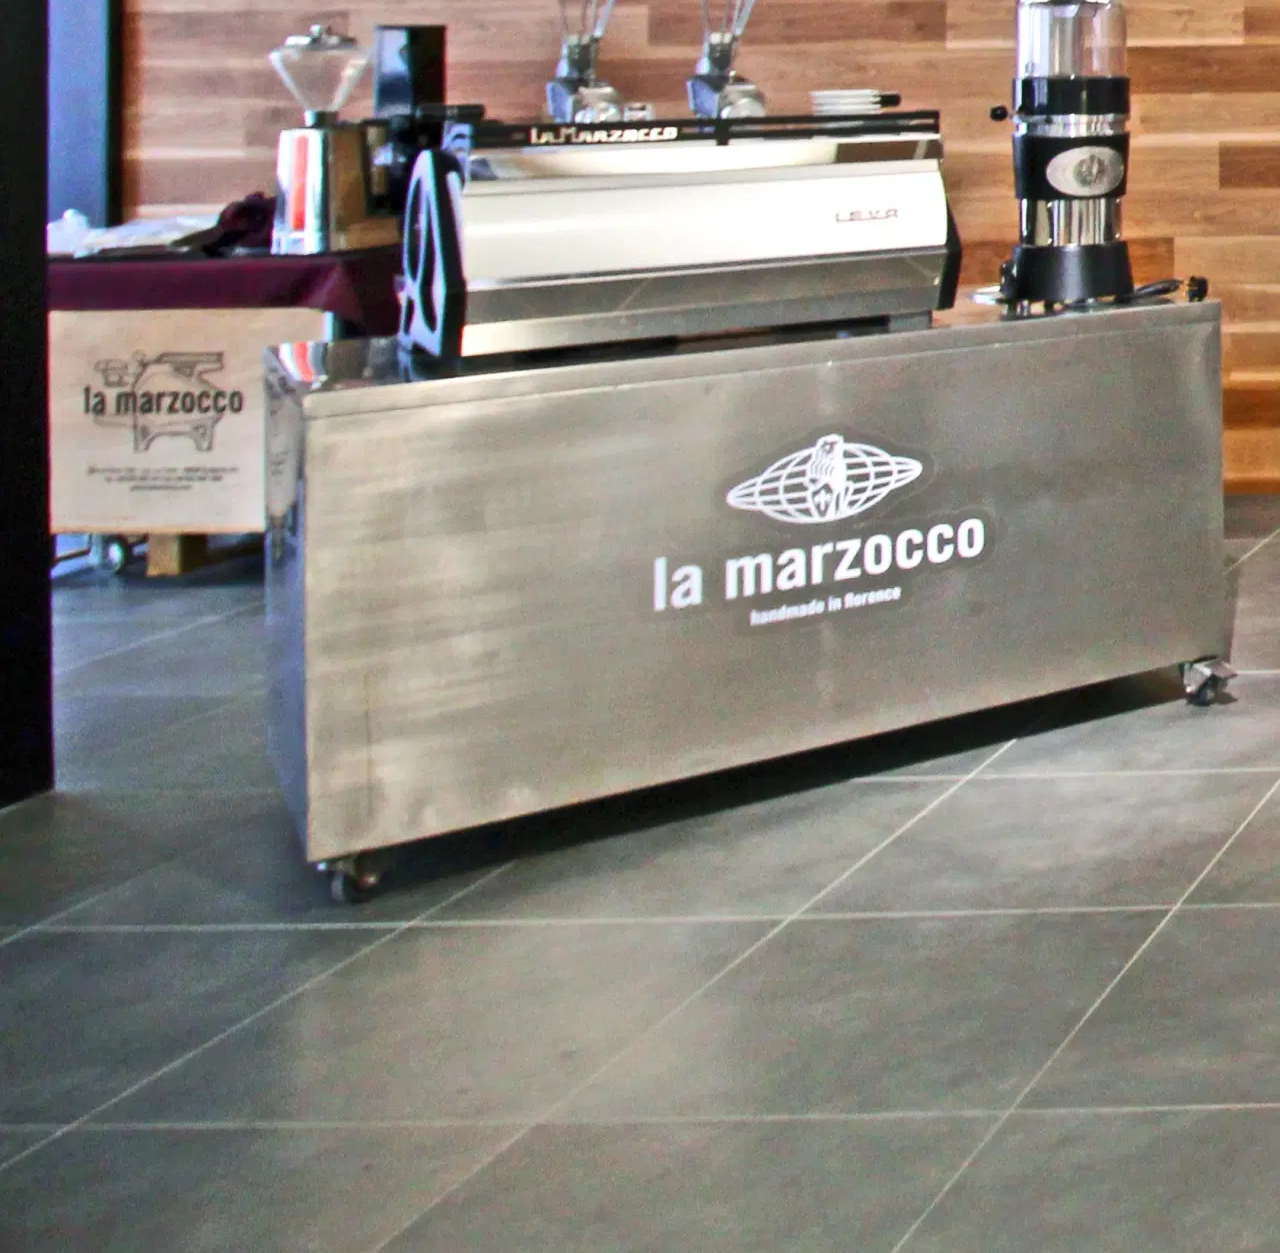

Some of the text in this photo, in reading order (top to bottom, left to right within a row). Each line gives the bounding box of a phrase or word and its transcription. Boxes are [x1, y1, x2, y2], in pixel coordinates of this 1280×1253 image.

[83, 384, 244, 415] la marzocco
[653, 518, 985, 612] la marzocco
[750, 587, 902, 626] handmade in florence
